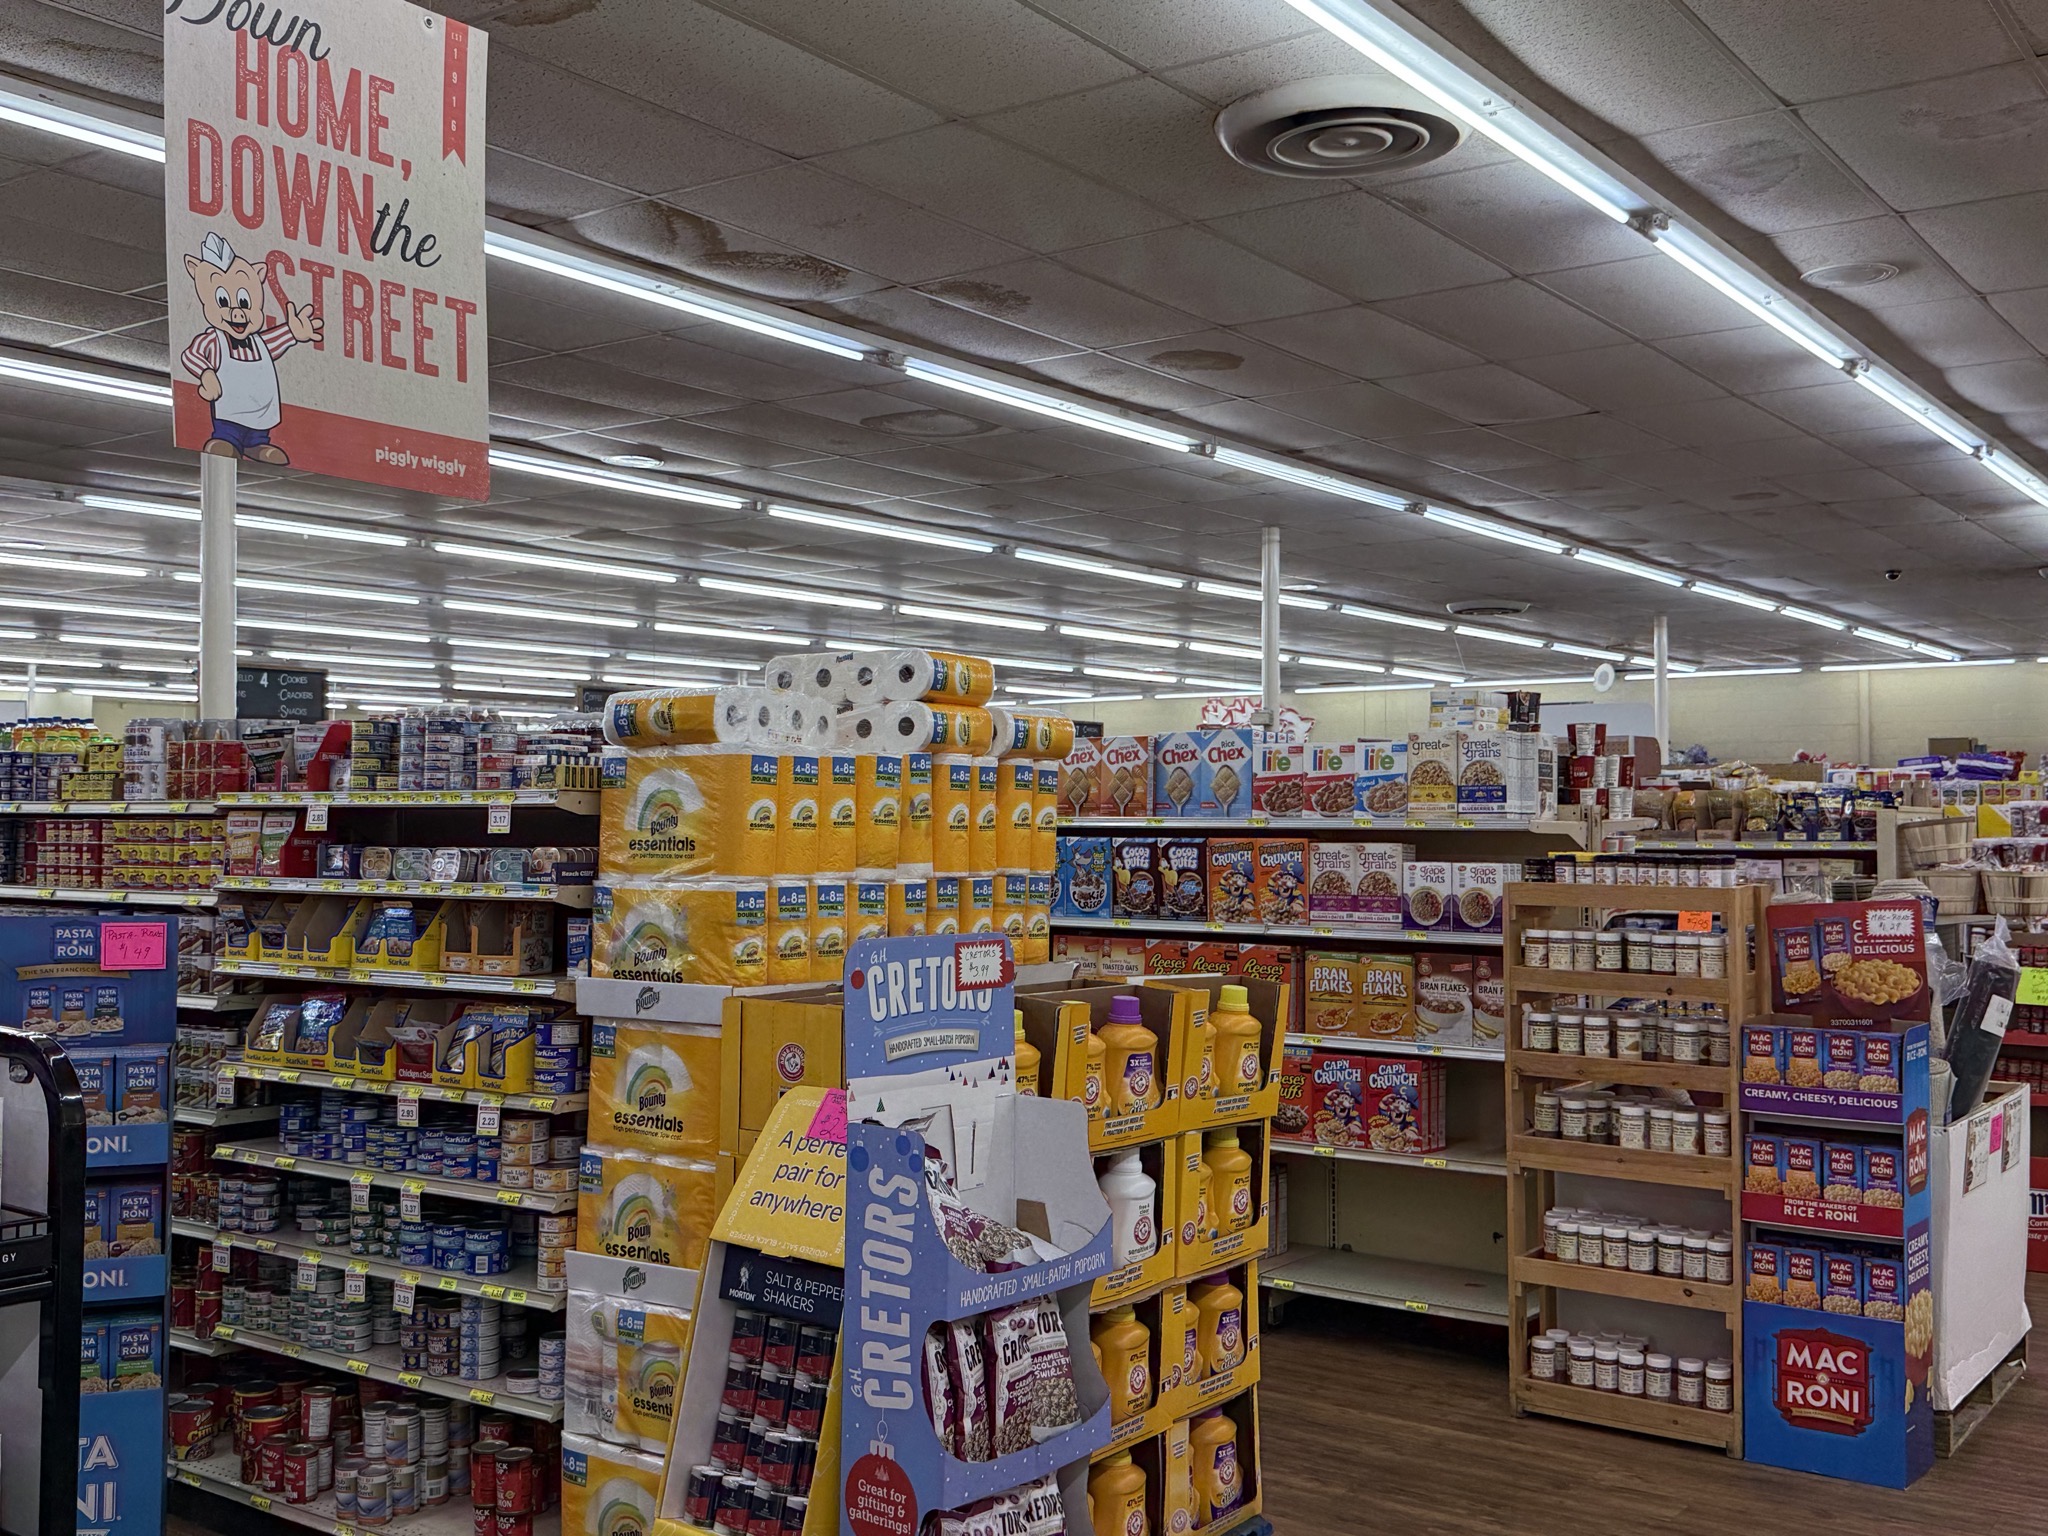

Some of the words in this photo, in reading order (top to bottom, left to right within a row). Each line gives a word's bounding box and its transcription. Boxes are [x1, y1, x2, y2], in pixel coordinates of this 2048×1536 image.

[235, 28, 412, 181] HOME,
[187, 118, 375, 262] DOWN
[370, 199, 442, 268] the
[265, 250, 477, 384] STREET
[375, 446, 419, 470] piggly
[421, 455, 467, 477] wiggly
[259, 672, 269, 688] 4
[1175, 742, 1189, 750] Rice
[1220, 740, 1235, 748] Rice
[1412, 740, 1441, 755] great
[1461, 740, 1491, 756] great
[1106, 747, 1141, 765] Chex
[1162, 749, 1199, 765] Chex
[1207, 746, 1246, 764] Chex
[1262, 747, 1291, 772] life
[1313, 748, 1343, 771] life
[1364, 747, 1394, 771] life
[1465, 748, 1501, 761] grains
[312, 814, 324, 822] 2.83
[493, 815, 506, 824] 3.17
[650, 814, 679, 836] Bounty
[629, 836, 696, 851] essentials
[1122, 846, 1151, 858] Cocoa
[1211, 851, 1252, 864] CRUNCH
[1313, 851, 1341, 866] great
[1317, 859, 1350, 872] grains
[1420, 865, 1446, 876] grape
[56, 929, 94, 939] PASTA
[1787, 935, 1808, 945] MAC
[57, 946, 94, 957] RONI
[965, 949, 997, 961] CRETORS
[1788, 946, 1809, 956] RONI
[1854, 943, 1915, 955] DELICIOUS
[1083, 961, 1097, 969] OATS
[1102, 963, 1125, 972] TOASTED
[1125, 963, 1139, 972] OATS
[1149, 953, 1186, 969] Reese's
[1192, 956, 1232, 973] Reese's
[55, 966, 97, 974] FRANCISCO
[613, 968, 683, 983] essentials
[969, 962, 990, 978] $3.99
[1313, 967, 1348, 980] BRAN
[1367, 970, 1402, 984] BRAN
[30, 989, 50, 997] PASTA
[1309, 979, 1353, 994] FLAKES
[1362, 982, 1407, 998] FLAKES
[1420, 981, 1439, 991] BRAN
[1441, 983, 1467, 993] FLAKES
[30, 998, 50, 1006] RONI
[1830, 1018, 1873, 1027] 33700311601
[888, 1037, 922, 1054] HANDCRAFTED
[923, 1034, 953, 1048] SMALL-BATCH
[954, 1033, 975, 1046] POPCORN
[1750, 1033, 1771, 1043] MAC
[1793, 1034, 1814, 1044] MAC
[1750, 1043, 1771, 1052] RONI
[1793, 1044, 1815, 1053] RONI
[285, 1057, 309, 1066] StarKist
[1130, 1059, 1140, 1067] 3X
[1324, 1060, 1350, 1071] CAP'N
[128, 1066, 156, 1076] PASTA
[360, 1066, 384, 1075] StarKist
[1378, 1064, 1406, 1075] CAP'N
[128, 1078, 156, 1088] RONI
[439, 1075, 461, 1084] StarKist
[1314, 1070, 1361, 1085] CRUNCH
[1369, 1073, 1418, 1088] CRUNCH
[638, 1091, 667, 1111] Bounty
[1744, 1088, 1790, 1102] CREAMY,
[1792, 1092, 1837, 1105] CHEESY,
[1839, 1096, 1899, 1109] DELICIOUS
[401, 1108, 415, 1118] 2.93
[482, 1116, 496, 1126] 2.23
[614, 1111, 684, 1134] essentials
[1908, 1121, 1926, 1142] MAC
[86, 1136, 132, 1154] ONI.
[777, 1130, 793, 1149] A
[793, 1135, 847, 1158] perfe
[1909, 1152, 1927, 1175] RONI
[772, 1160, 815, 1184] pair
[817, 1165, 846, 1190] for
[121, 1196, 150, 1207] PASTA
[404, 1203, 417, 1213] 3.37
[749, 1188, 843, 1223] anywhere
[1784, 1198, 1802, 1206] FROM
[1816, 1202, 1845, 1211] MAKERS
[122, 1208, 149, 1219] RONI
[1784, 1205, 1815, 1218] RICE
[215, 1254, 227, 1264] 1.83
[301, 1272, 313, 1283] 1.33
[765, 1270, 793, 1290] SALT
[793, 1278, 803, 1292] &
[960, 1279, 1018, 1308] HANDCRAFTED
[1021, 1266, 1071, 1290] SMALL-BATCH
[1074, 1252, 1106, 1277] POPCORN
[349, 1283, 362, 1293] 1.33
[729, 1287, 756, 1302] MORTON
[862, 1164, 920, 1411] CRETORS
[512, 1291, 524, 1299] WIC
[763, 1288, 815, 1313] SHAKERS
[1786, 1343, 1859, 1375] MAC
[649, 1382, 674, 1398] Bounty
[1787, 1381, 1860, 1414] RONI
[858, 1478, 888, 1496] Great
[890, 1489, 907, 1504] for
[858, 1495, 896, 1518] gifting
[898, 1505, 905, 1518] &
[849, 1507, 912, 1535] gatherings!
